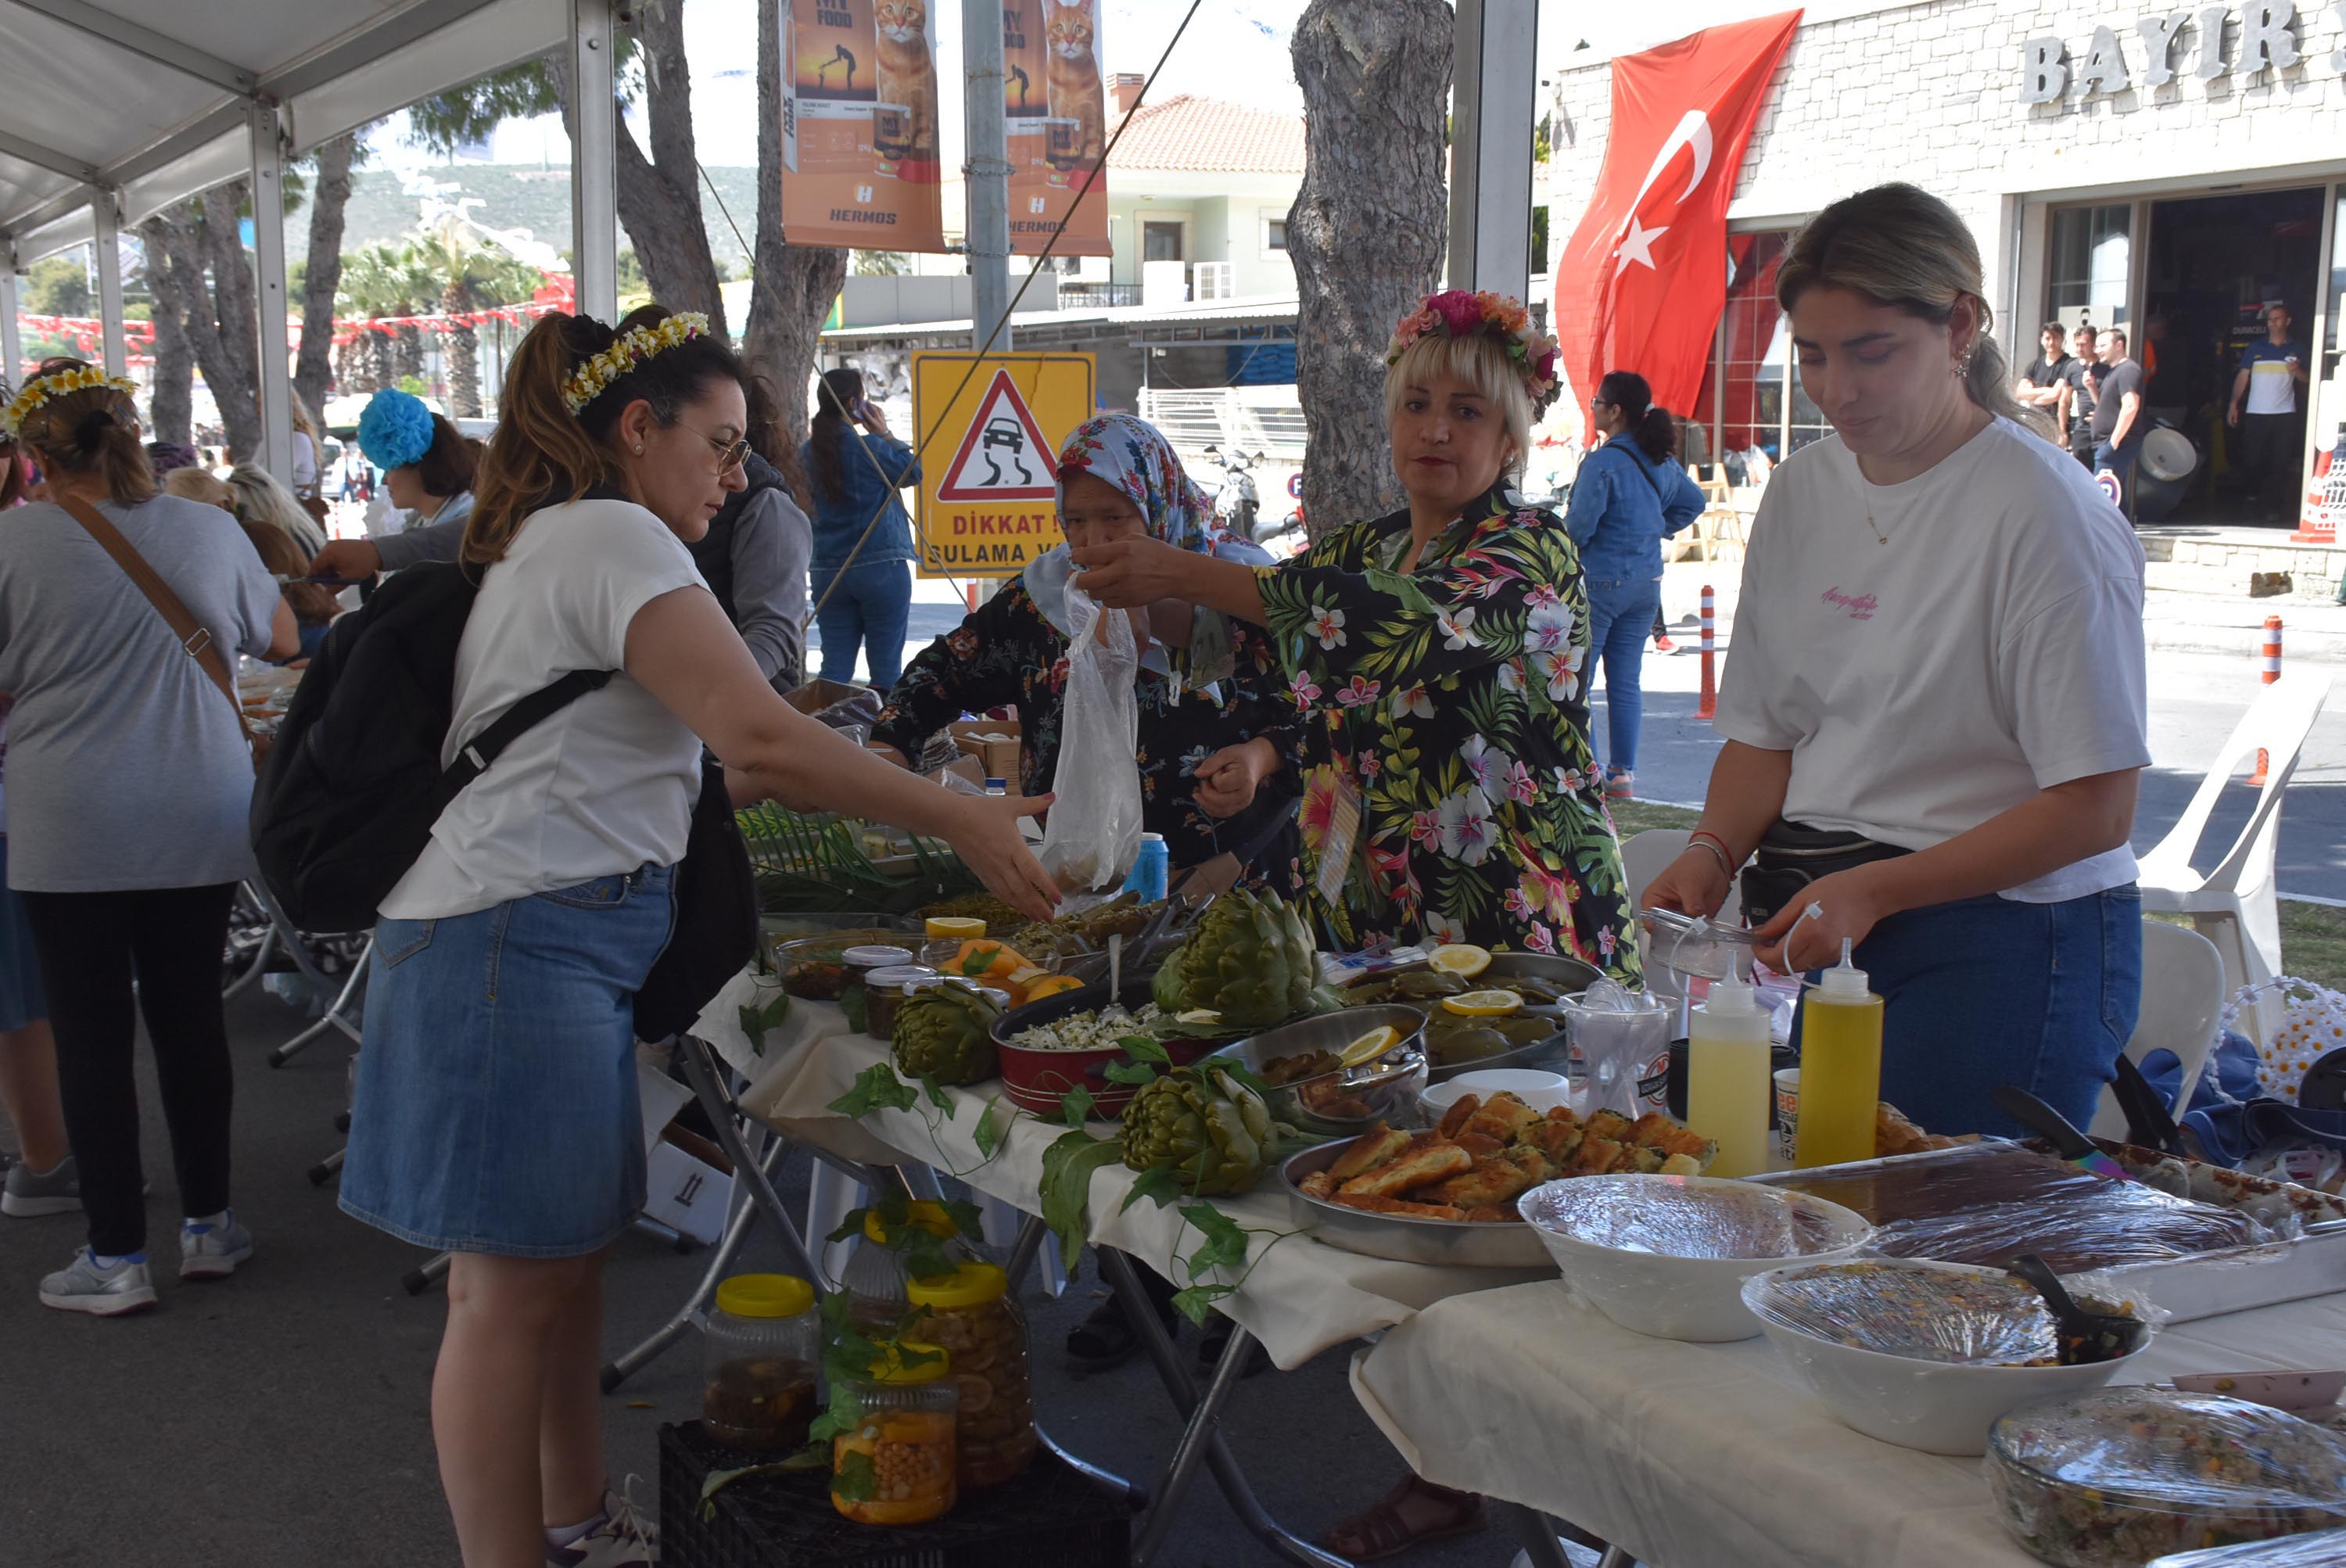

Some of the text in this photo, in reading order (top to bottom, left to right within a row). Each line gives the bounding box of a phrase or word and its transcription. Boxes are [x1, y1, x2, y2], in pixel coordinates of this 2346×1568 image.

[816, 9, 852, 28] FOOD
[2019, 0, 2301, 104] BAYIR
[830, 209, 897, 224] HERMOS
[953, 511, 1046, 535] DİKKAT
[927, 544, 1026, 564] SULAMA
